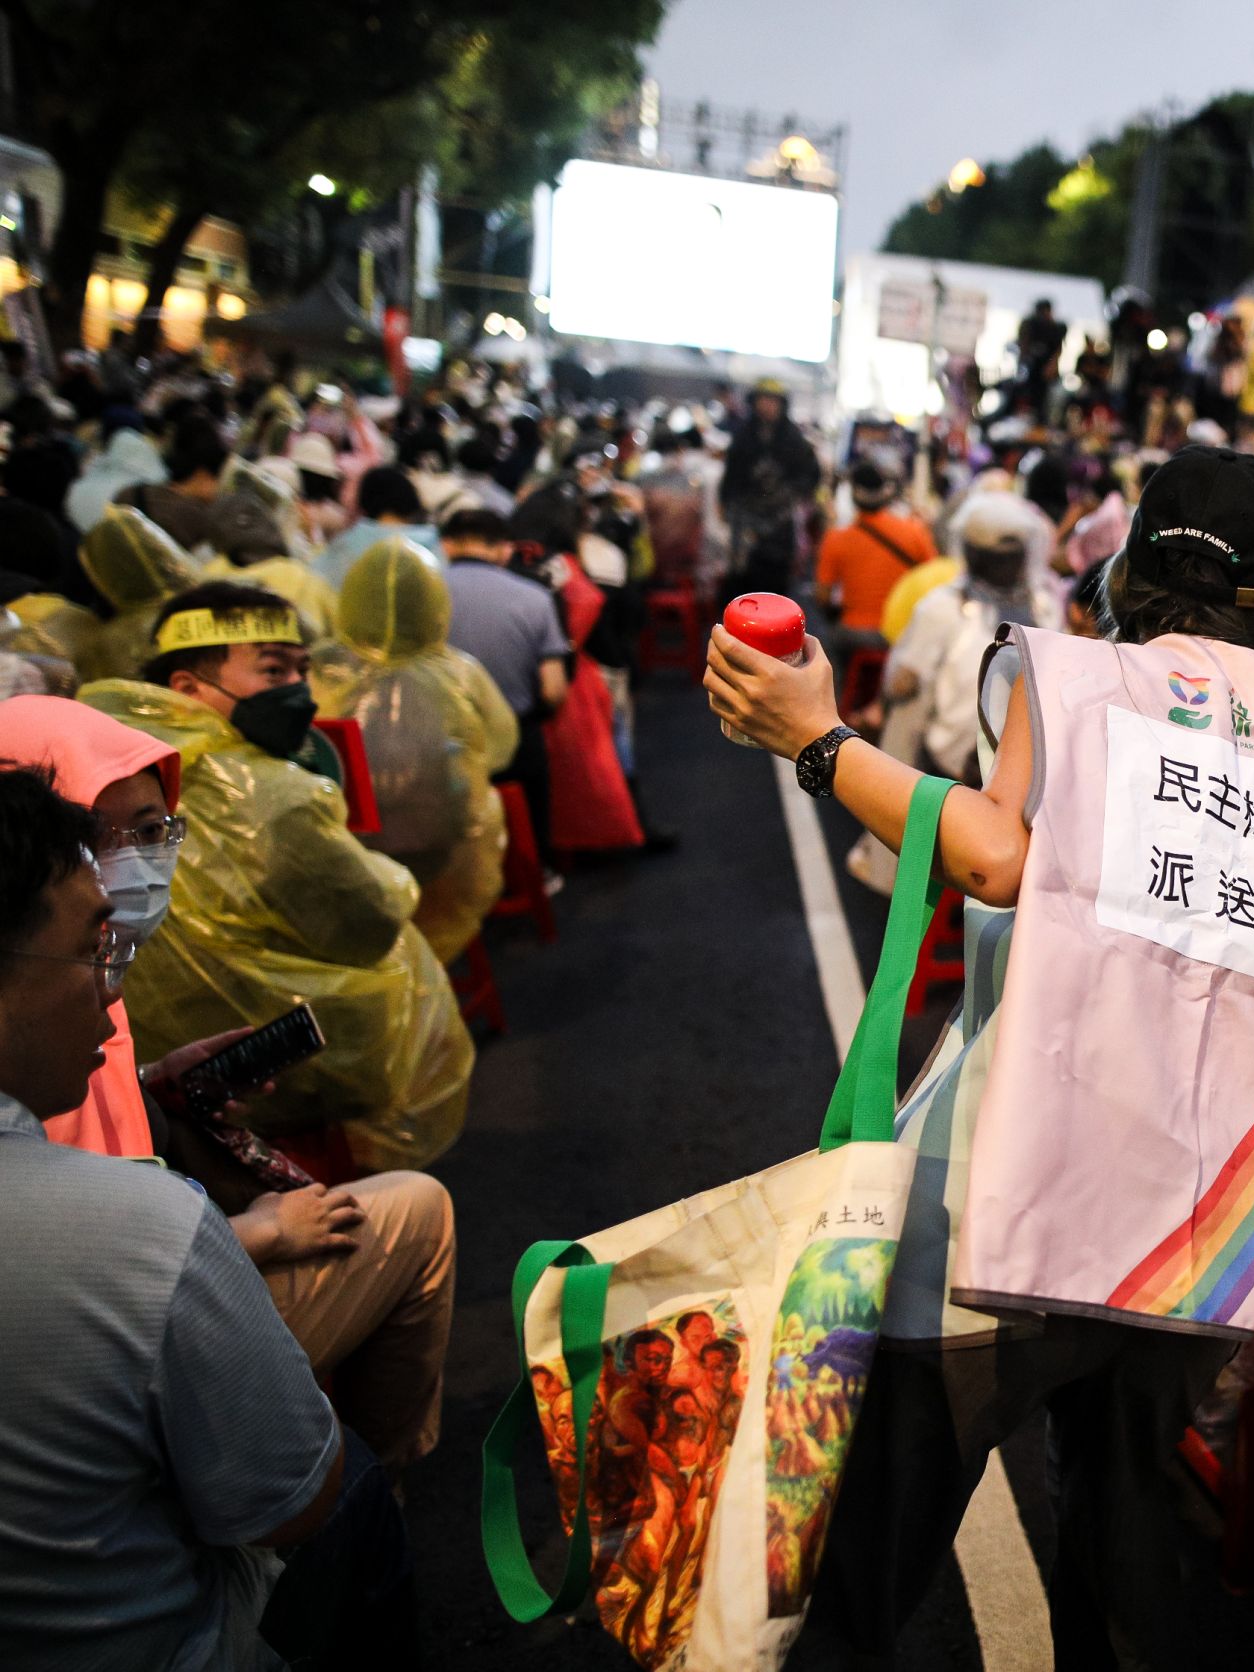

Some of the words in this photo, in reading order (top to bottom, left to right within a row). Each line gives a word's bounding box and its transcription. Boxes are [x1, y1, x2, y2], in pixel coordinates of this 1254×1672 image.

[1159, 527, 1183, 537] WEED
[1184, 527, 1203, 538] ARE
[1203, 533, 1235, 554] FAMILY
